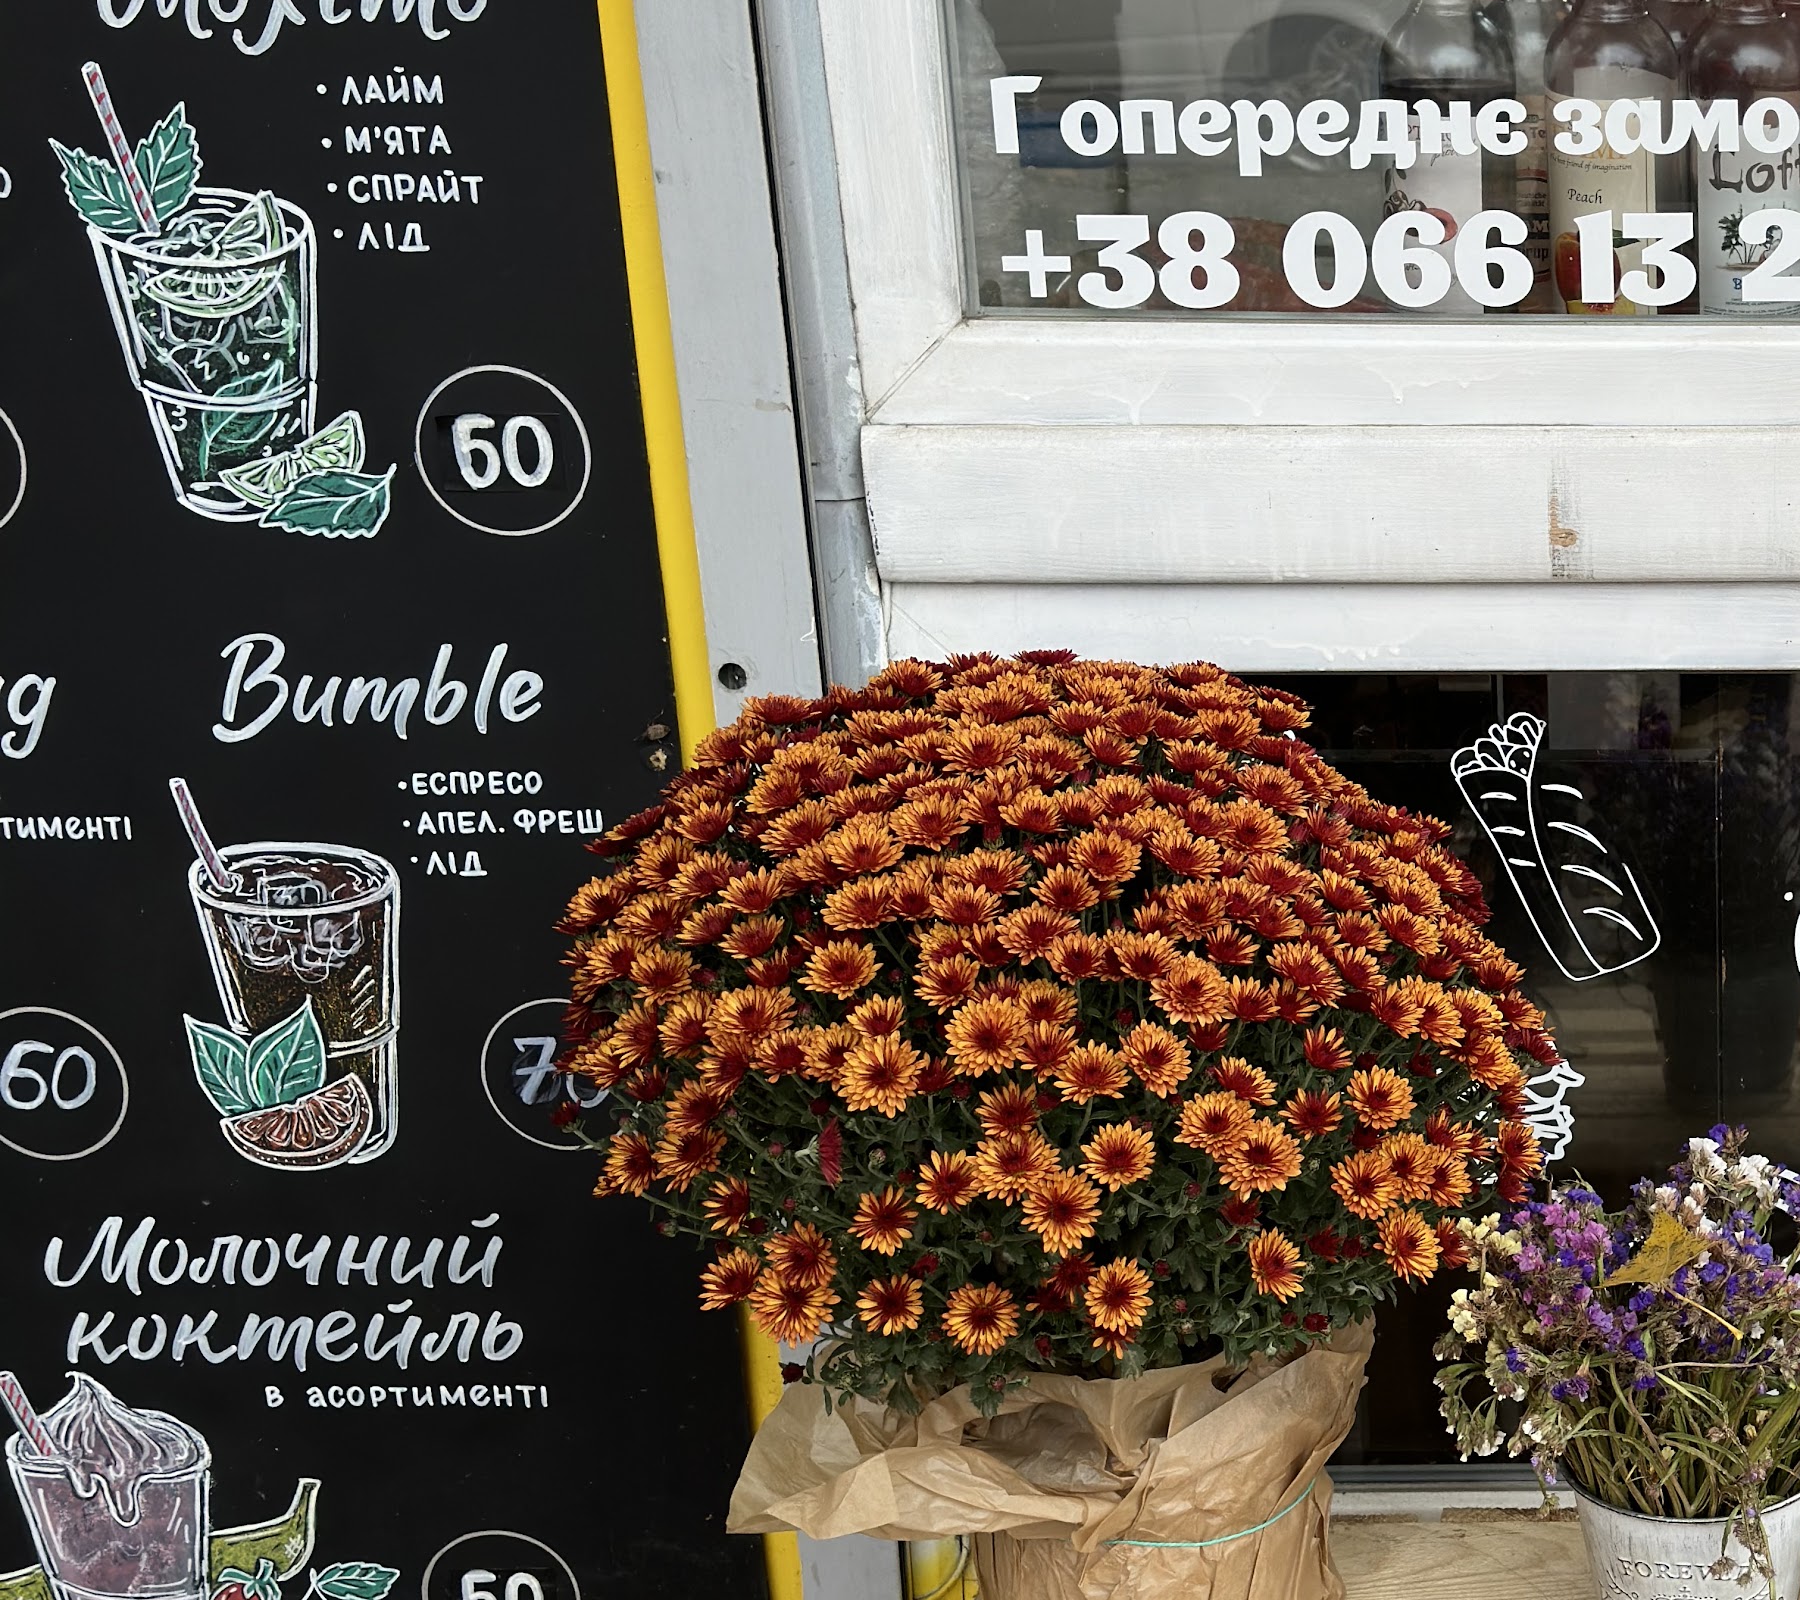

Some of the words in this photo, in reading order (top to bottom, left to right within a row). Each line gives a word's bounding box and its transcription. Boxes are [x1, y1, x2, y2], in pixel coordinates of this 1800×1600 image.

[341, 67, 444, 104] ЛАЙМ
[345, 125, 452, 155] М'ЯТА
[347, 170, 485, 205] СПРАЙТ
[1568, 189, 1602, 204] Peach
[357, 223, 430, 252] ЛІД
[1002, 211, 1240, 308] +38
[1282, 209, 1534, 308] 066
[1574, 209, 1697, 306] 13
[452, 413, 554, 489] 60
[212, 633, 544, 743] Bumble
[412, 771, 543, 795] ЕСПРЕСО
[417, 810, 505, 835] АПЕЛ.
[513, 808, 603, 834] ФРЕШ
[427, 851, 488, 877] ЛІД
[0, 1040, 97, 1110] 60
[44, 1213, 502, 1295] Молочний
[66, 1299, 524, 1371] коктейль
[306, 1385, 549, 1409] асортименті
